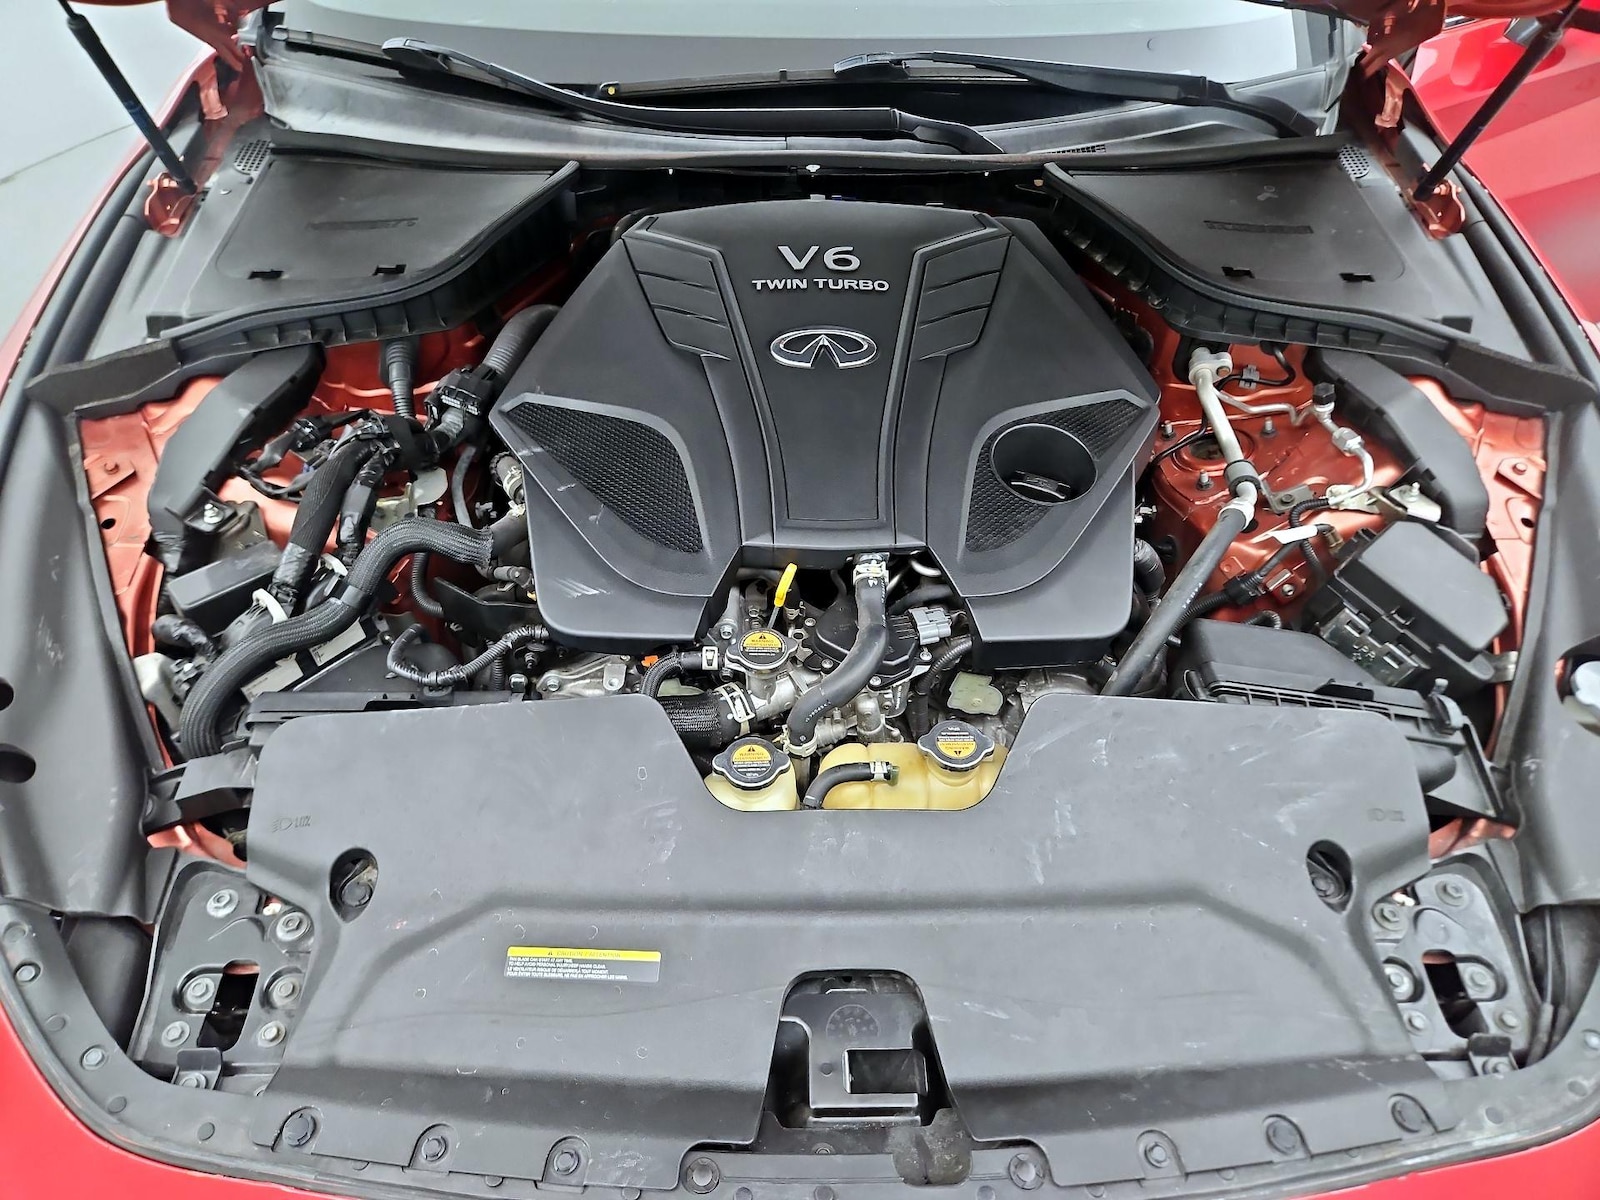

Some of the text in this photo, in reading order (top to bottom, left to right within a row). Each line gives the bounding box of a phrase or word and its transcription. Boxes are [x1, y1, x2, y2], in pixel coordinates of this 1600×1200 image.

[777, 245, 861, 271] V6
[752, 278, 890, 291] TWIN TURBO
